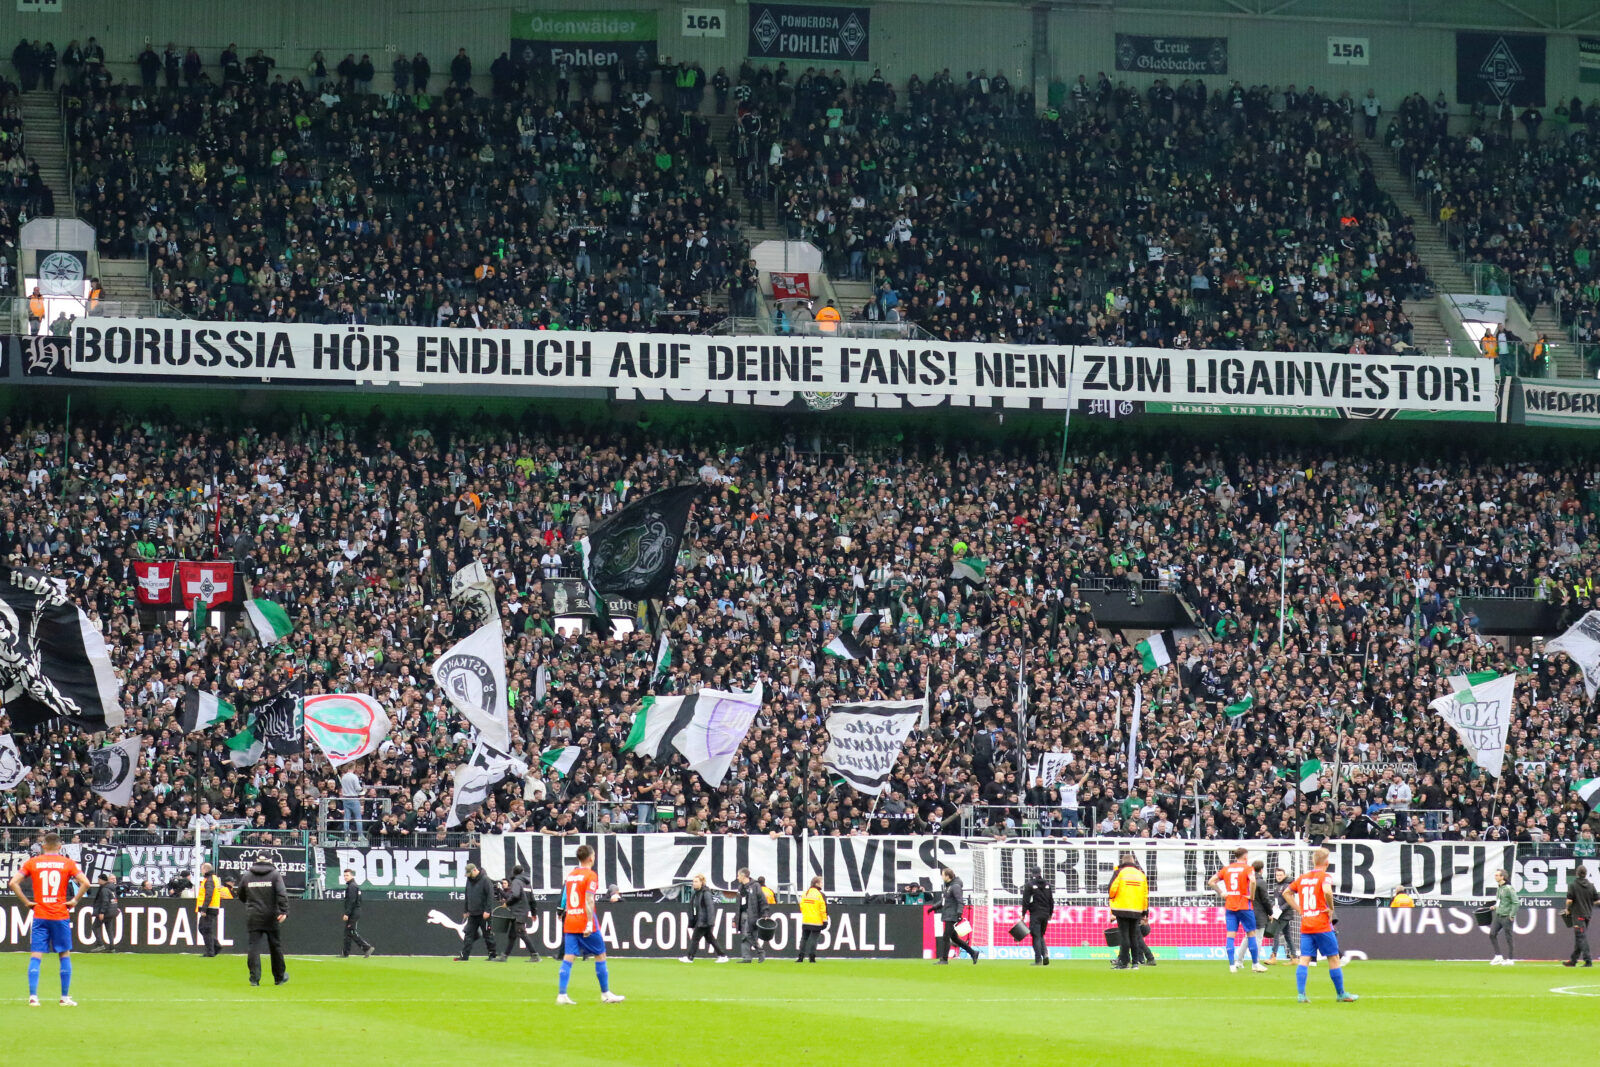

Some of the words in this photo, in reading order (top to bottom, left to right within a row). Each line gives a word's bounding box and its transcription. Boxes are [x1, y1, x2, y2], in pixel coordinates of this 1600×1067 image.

[531, 16, 636, 34] Odenwälder
[686, 15, 721, 29] 16A
[781, 15, 839, 29] PONDEROSA
[780, 33, 839, 54] FOHLEN
[1152, 39, 1190, 54] Treue
[1332, 43, 1364, 57] 15A
[550, 48, 618, 66] Fohlen
[1136, 55, 1207, 71] Gladbacher
[75, 326, 296, 369] BORUSSIA
[313, 326, 400, 371] HÖR
[416, 336, 592, 377] ENDLICH
[608, 341, 691, 379] AUF
[707, 345, 823, 383] DEINE
[840, 346, 957, 385] FANS!
[975, 352, 1066, 388] NEIN
[1082, 355, 1171, 393] ZUM
[1186, 357, 1481, 402] LIGAINVESTOR!
[1525, 389, 1600, 413] NIEDER
[1171, 404, 1222, 415] IMMER
[1229, 405, 1256, 415] UND
[1263, 405, 1332, 417] ÜBERALL!
[127, 845, 205, 866] VITUS
[672, 835, 750, 893] ZU
[777, 836, 1158, 894] INVESOREN
[39, 870, 61, 896] 19
[1230, 872, 1239, 891] 5
[386, 890, 424, 900] flatex
[570, 883, 580, 908] 6
[1169, 897, 1215, 907] flatex
[1302, 886, 1317, 911] 16
[1520, 898, 1552, 907] flatex
